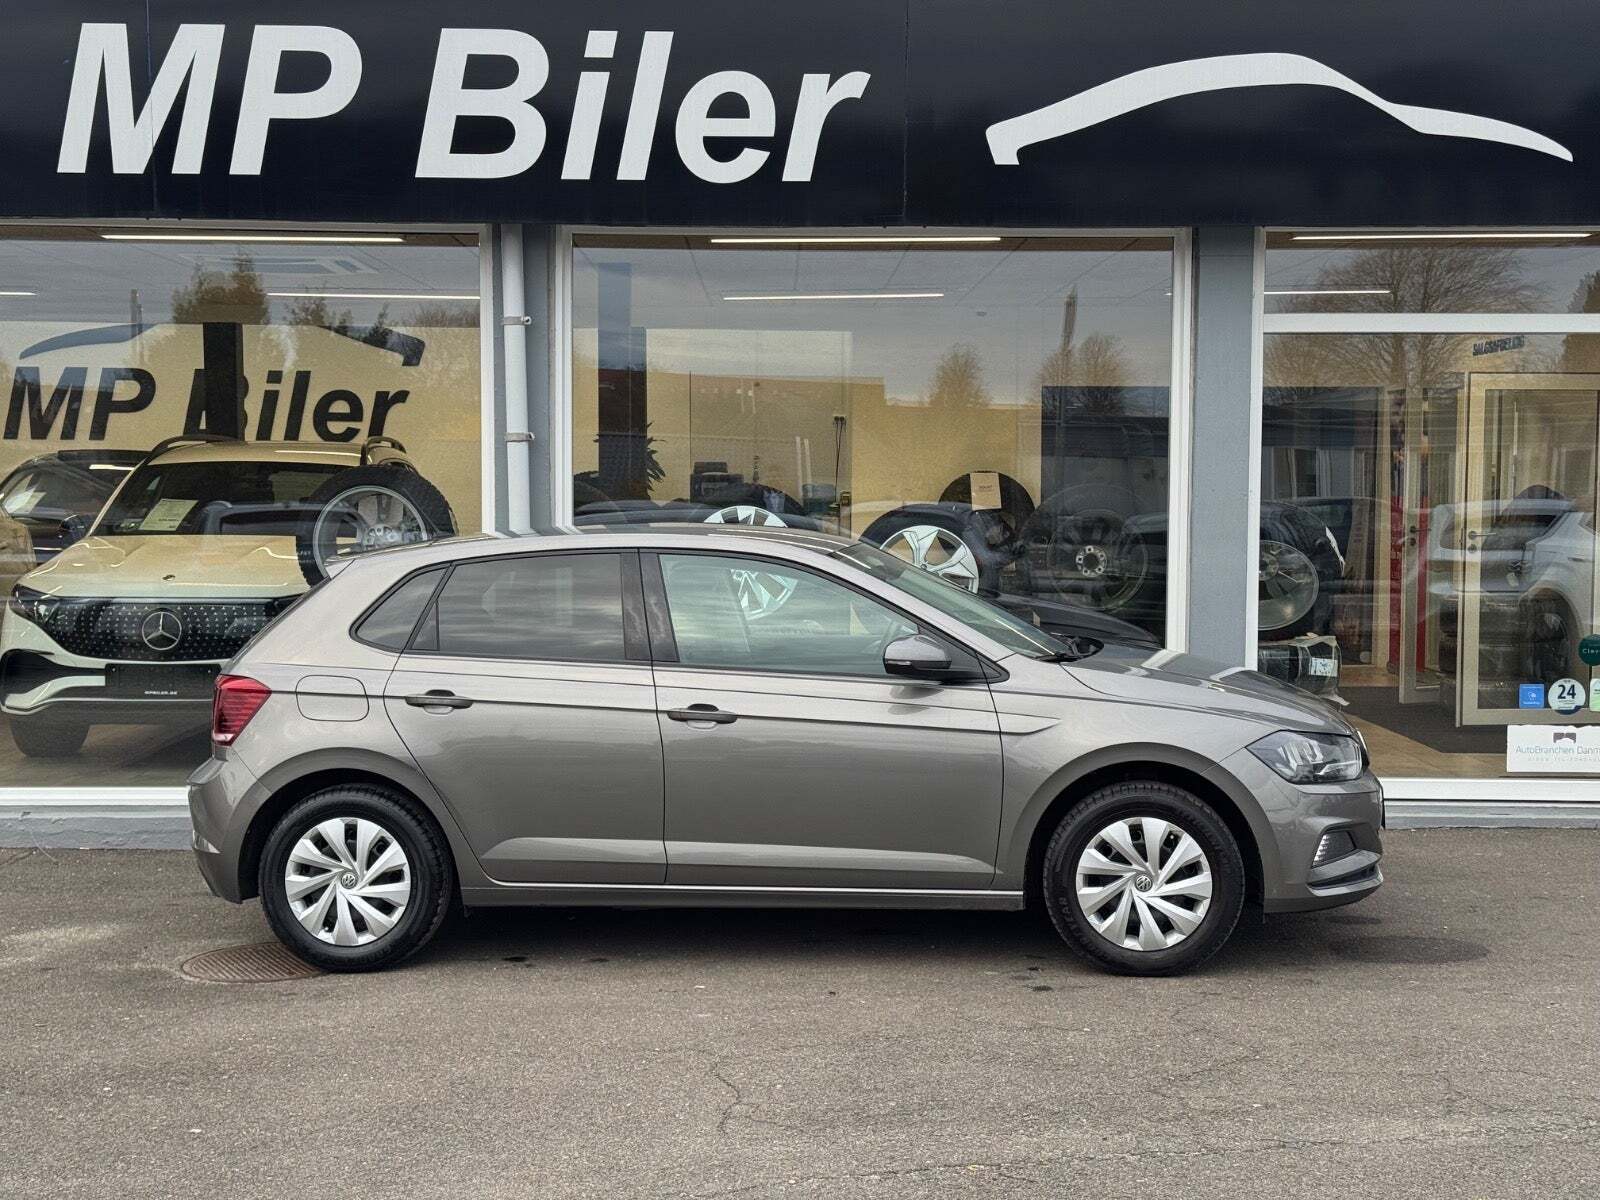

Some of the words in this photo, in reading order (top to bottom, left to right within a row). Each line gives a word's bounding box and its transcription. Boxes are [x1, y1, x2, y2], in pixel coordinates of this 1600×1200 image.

[58, 23, 362, 175] MP
[416, 28, 870, 183] Biler
[3, 366, 156, 441] MP
[1557, 684, 1577, 700] 24
[1515, 745, 1575, 754] AutoBranchen
